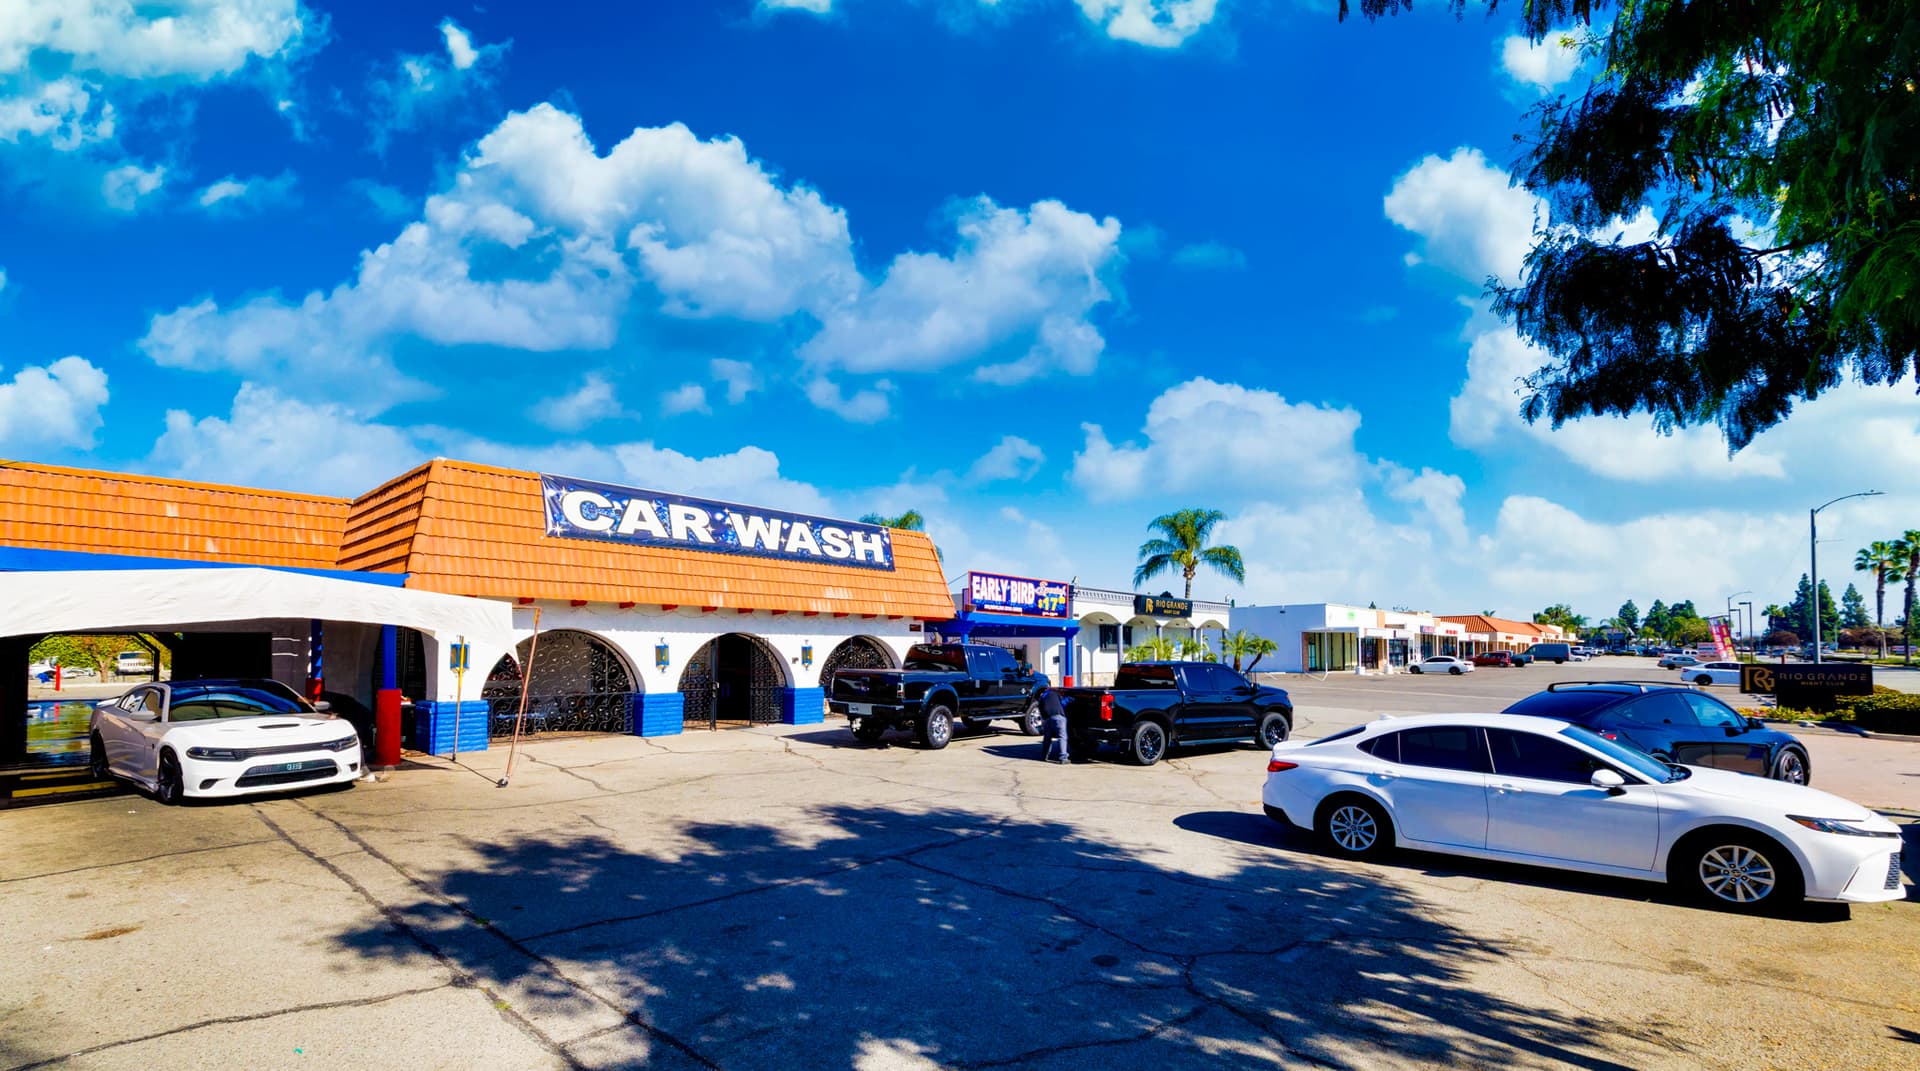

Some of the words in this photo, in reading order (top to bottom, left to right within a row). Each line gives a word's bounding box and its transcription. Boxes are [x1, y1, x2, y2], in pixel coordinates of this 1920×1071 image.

[561, 490, 715, 544] CAR
[728, 511, 886, 564] WASH
[972, 575, 1008, 602] EARLY
[1010, 580, 1035, 605] BIRD
[1155, 599, 1165, 608] RIO
[1166, 601, 1188, 610] GRANDE
[1779, 672, 1803, 680] RIO
[1807, 672, 1869, 681] GRANDE
